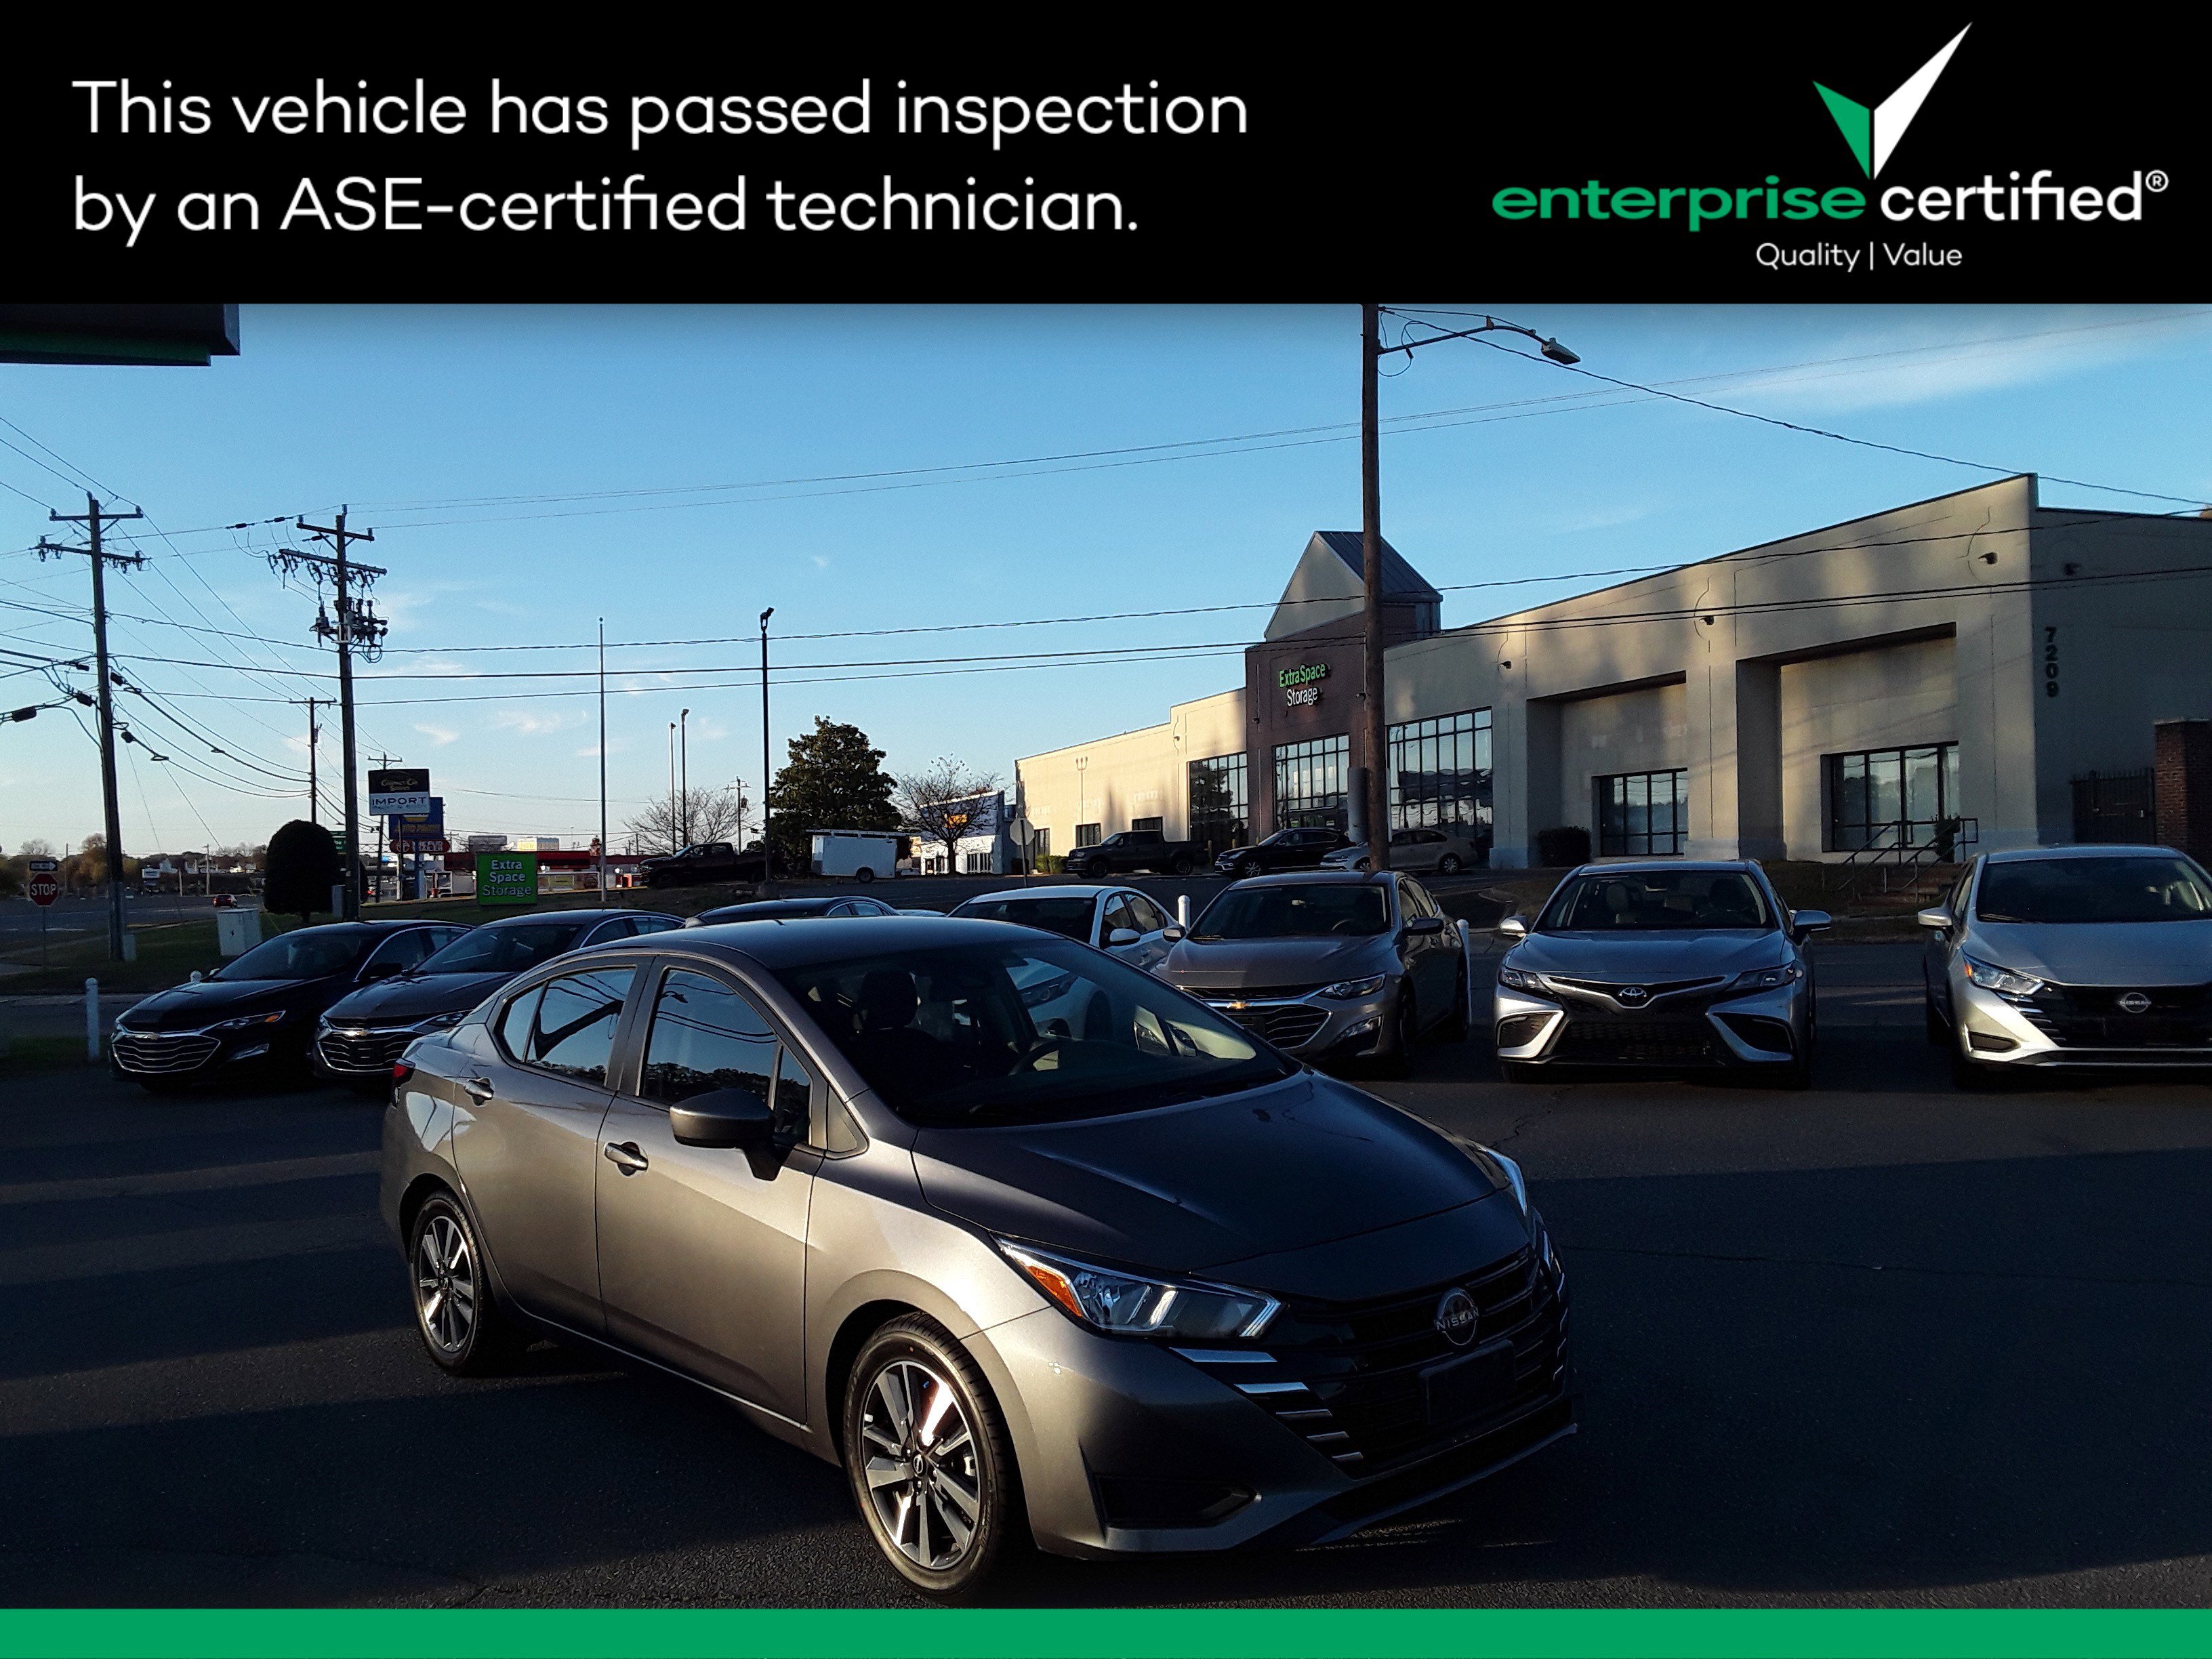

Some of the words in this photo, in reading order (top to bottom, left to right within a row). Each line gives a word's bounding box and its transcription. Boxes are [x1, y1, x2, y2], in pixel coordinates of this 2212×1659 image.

[2045, 626, 2060, 698] 7209
[1287, 687, 1318, 707] Storage
[372, 797, 426, 806] IMPORT
[491, 859, 522, 869] Extra
[489, 872, 526, 884] Space
[30, 884, 57, 896] STOP
[483, 884, 532, 897] Storage
[1436, 1309, 1479, 1330] NISSAN
